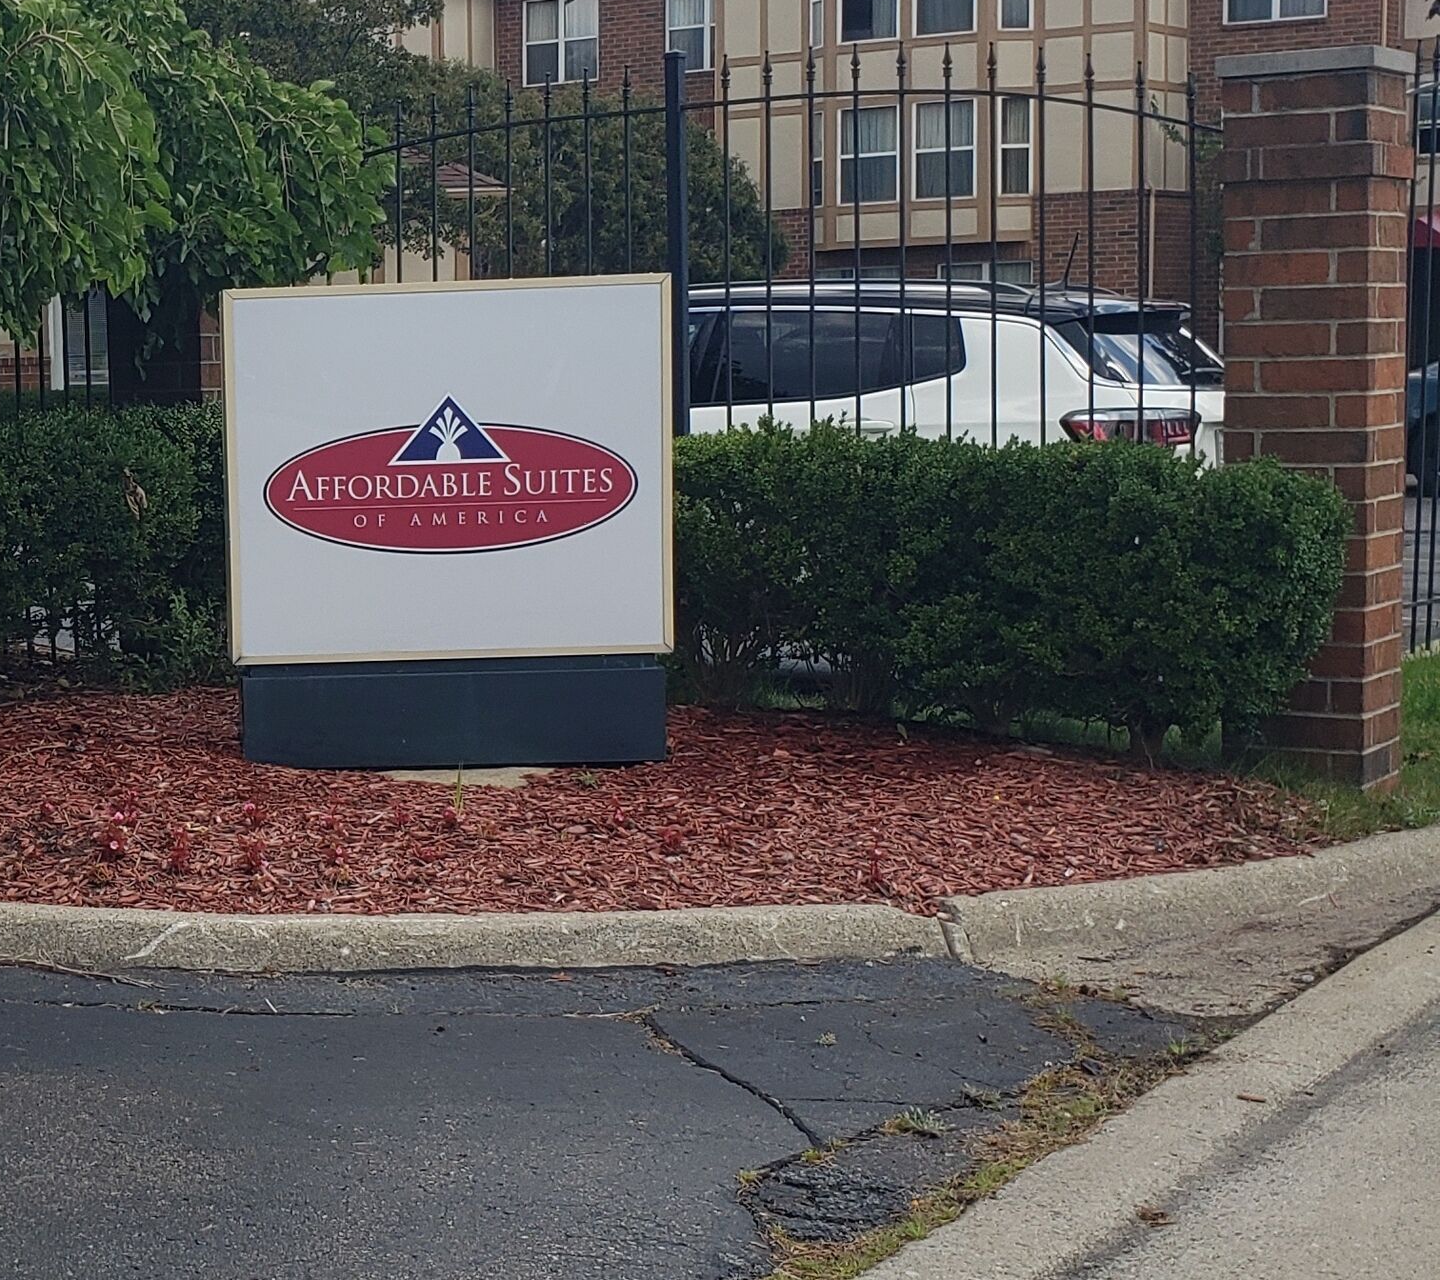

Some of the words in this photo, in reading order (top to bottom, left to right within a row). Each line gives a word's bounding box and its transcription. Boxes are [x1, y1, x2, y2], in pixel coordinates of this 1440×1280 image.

[285, 469, 492, 502] AFFORDABLE
[503, 463, 613, 496] SUITES
[353, 513, 386, 528] OF
[410, 509, 548, 527] AMERICA
